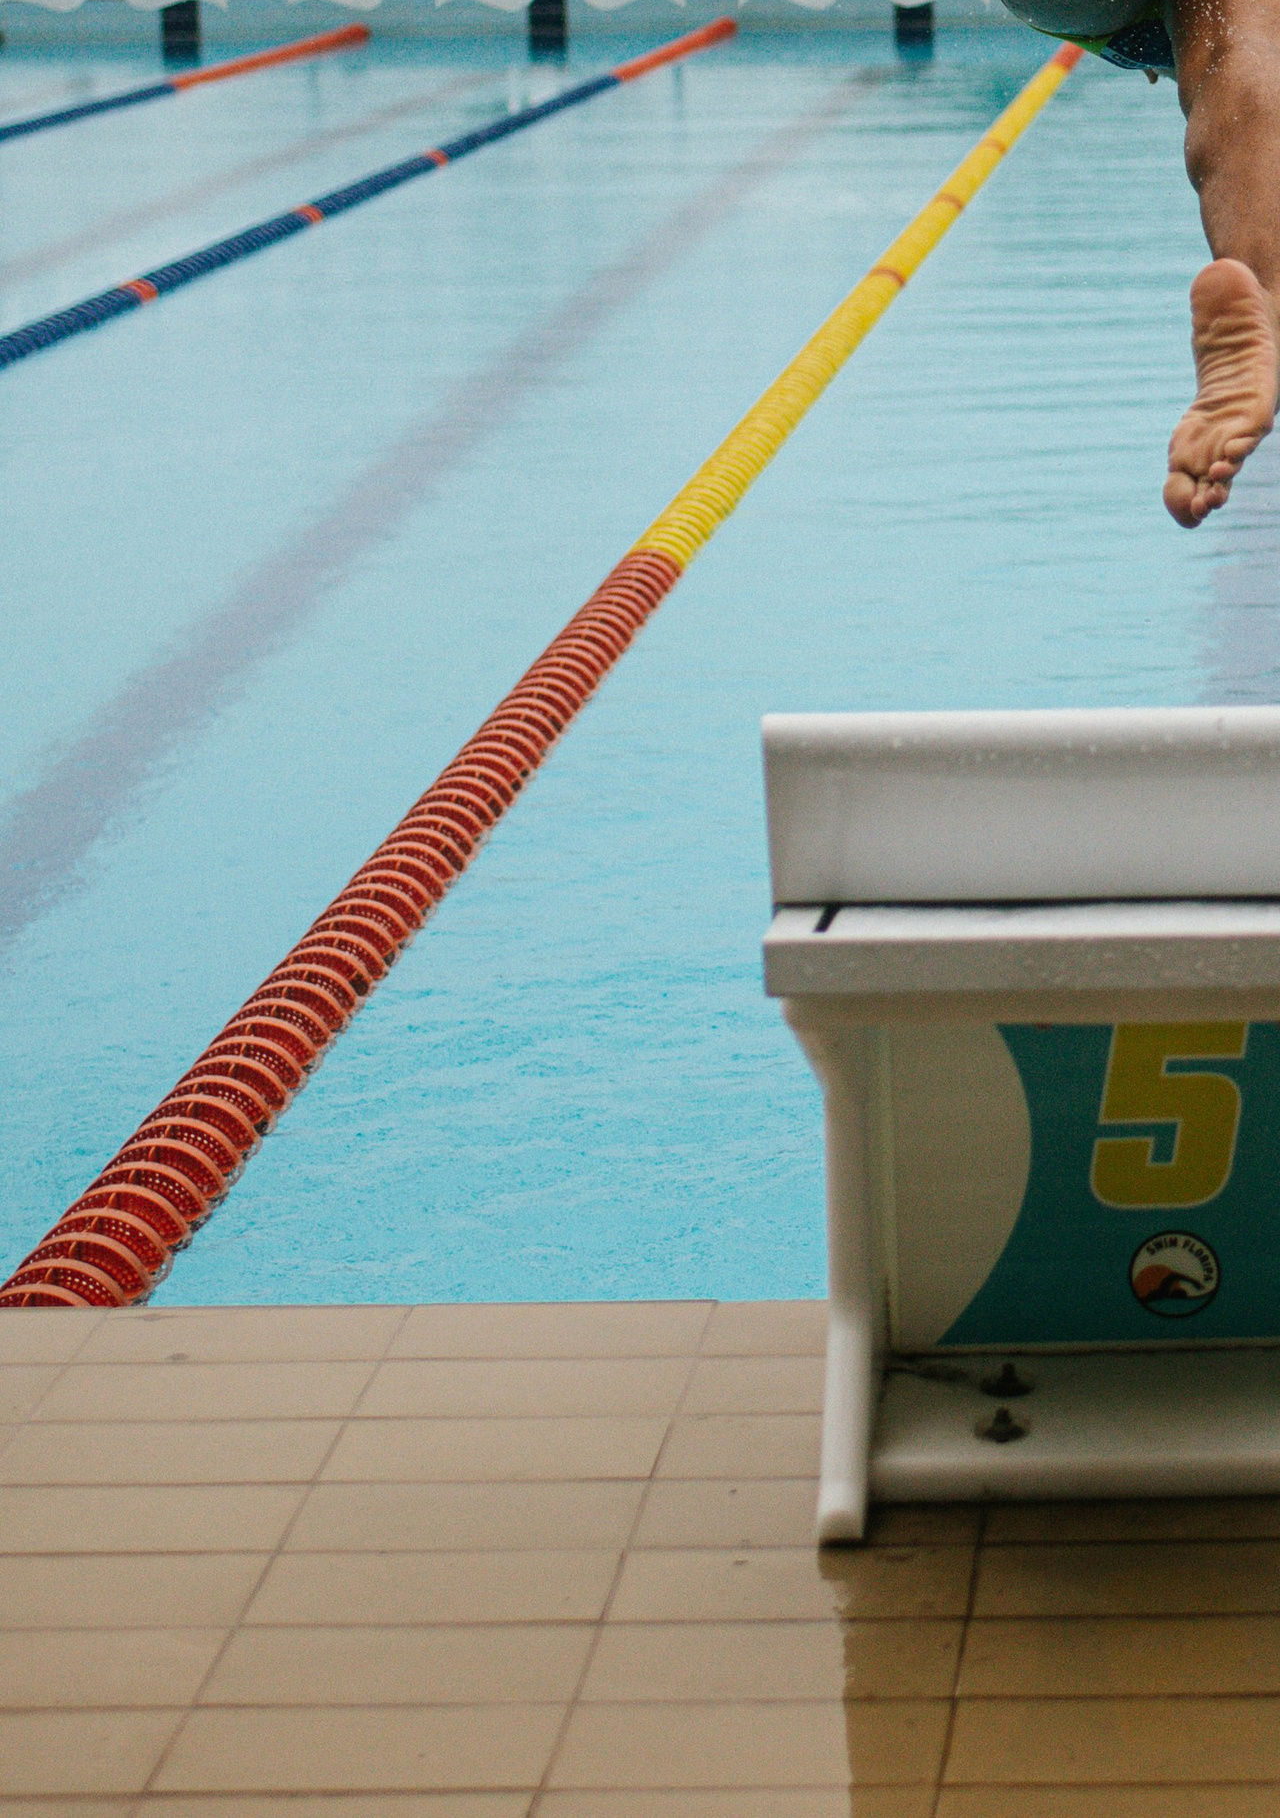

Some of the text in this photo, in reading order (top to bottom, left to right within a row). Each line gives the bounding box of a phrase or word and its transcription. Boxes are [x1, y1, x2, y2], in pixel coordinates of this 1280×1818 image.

[1090, 1021, 1250, 1209] 5
[1146, 1236, 1214, 1282] SWIM FLORIPA
